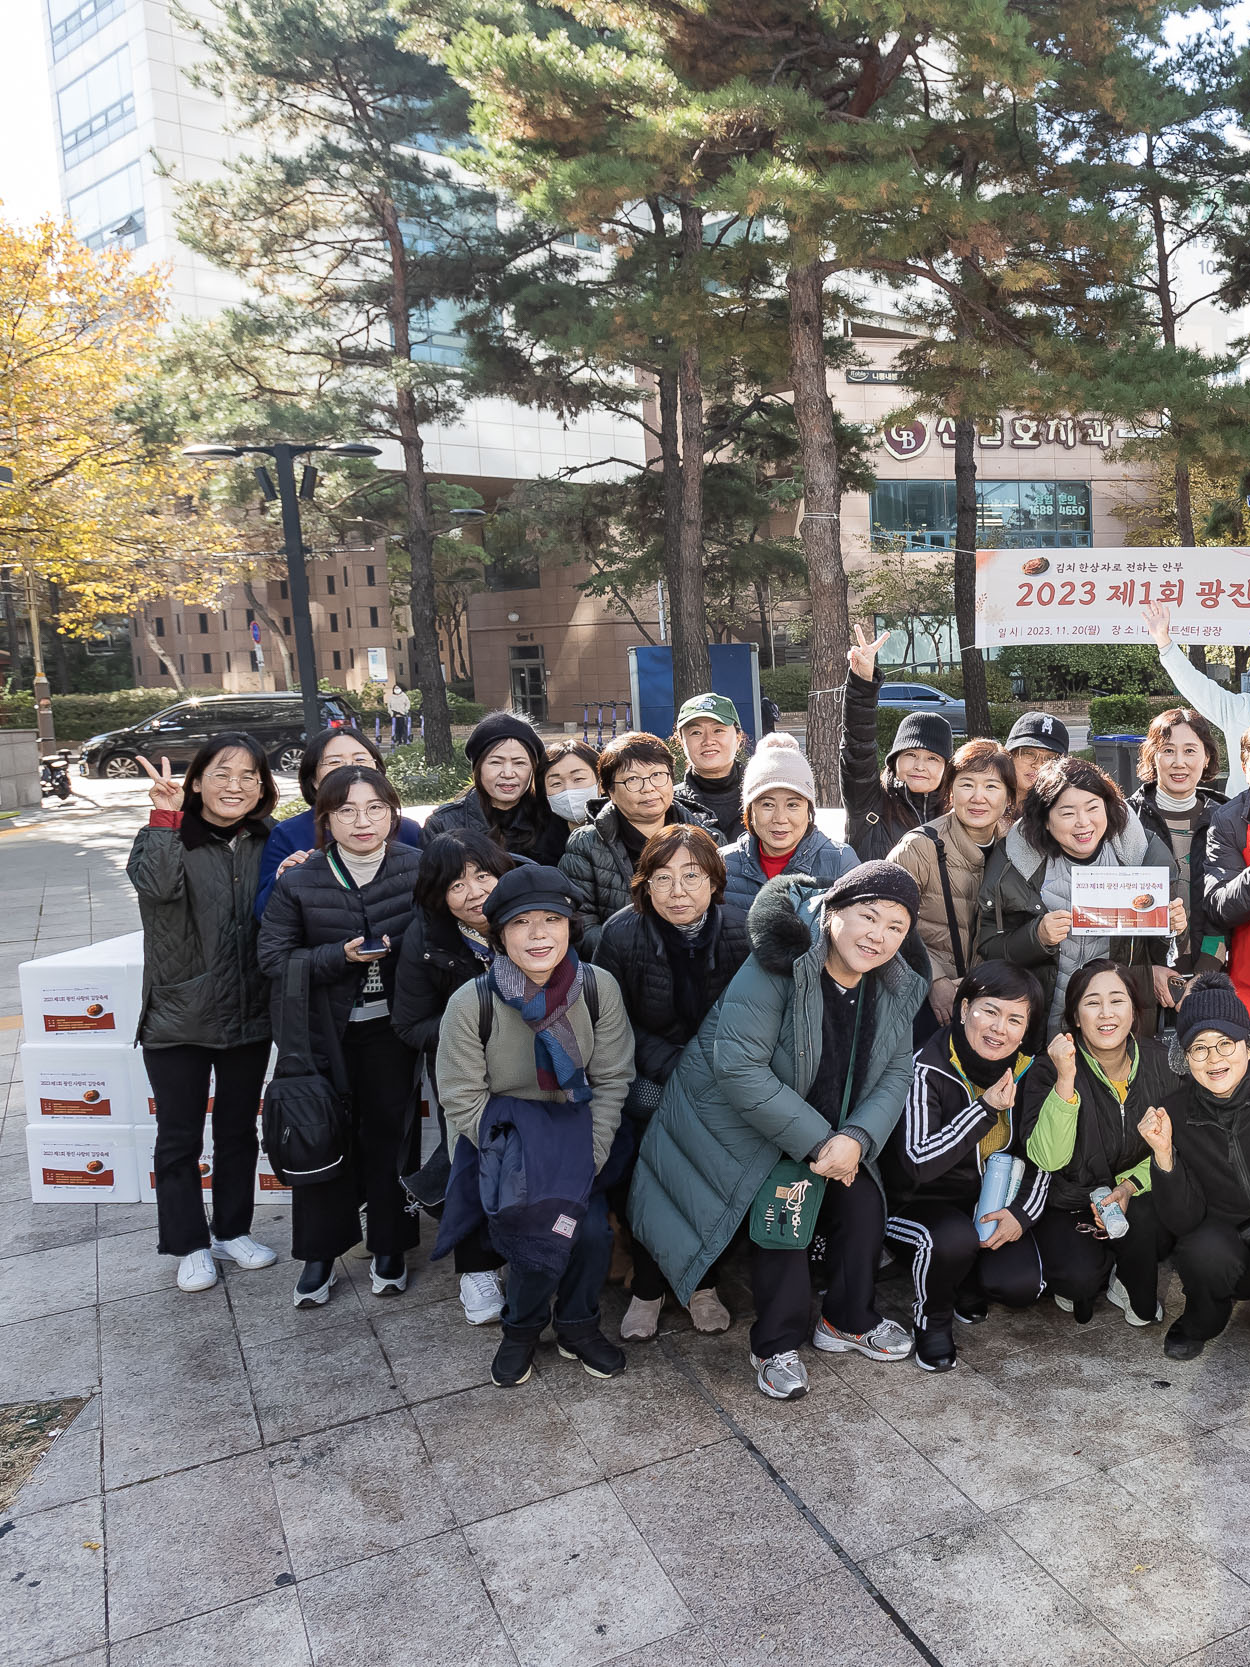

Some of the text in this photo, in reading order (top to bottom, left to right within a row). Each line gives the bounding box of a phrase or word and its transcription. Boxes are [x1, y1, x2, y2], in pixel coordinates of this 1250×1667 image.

[1030, 505, 1085, 515] 1688 4650
[1056, 561, 1184, 574] 김치 한상자로 전하는 안부
[1015, 580, 1096, 607] 2023
[1106, 578, 1185, 608] 제1회
[1141, 625, 1200, 637] 나트센터
[1202, 626, 1222, 637] 광장
